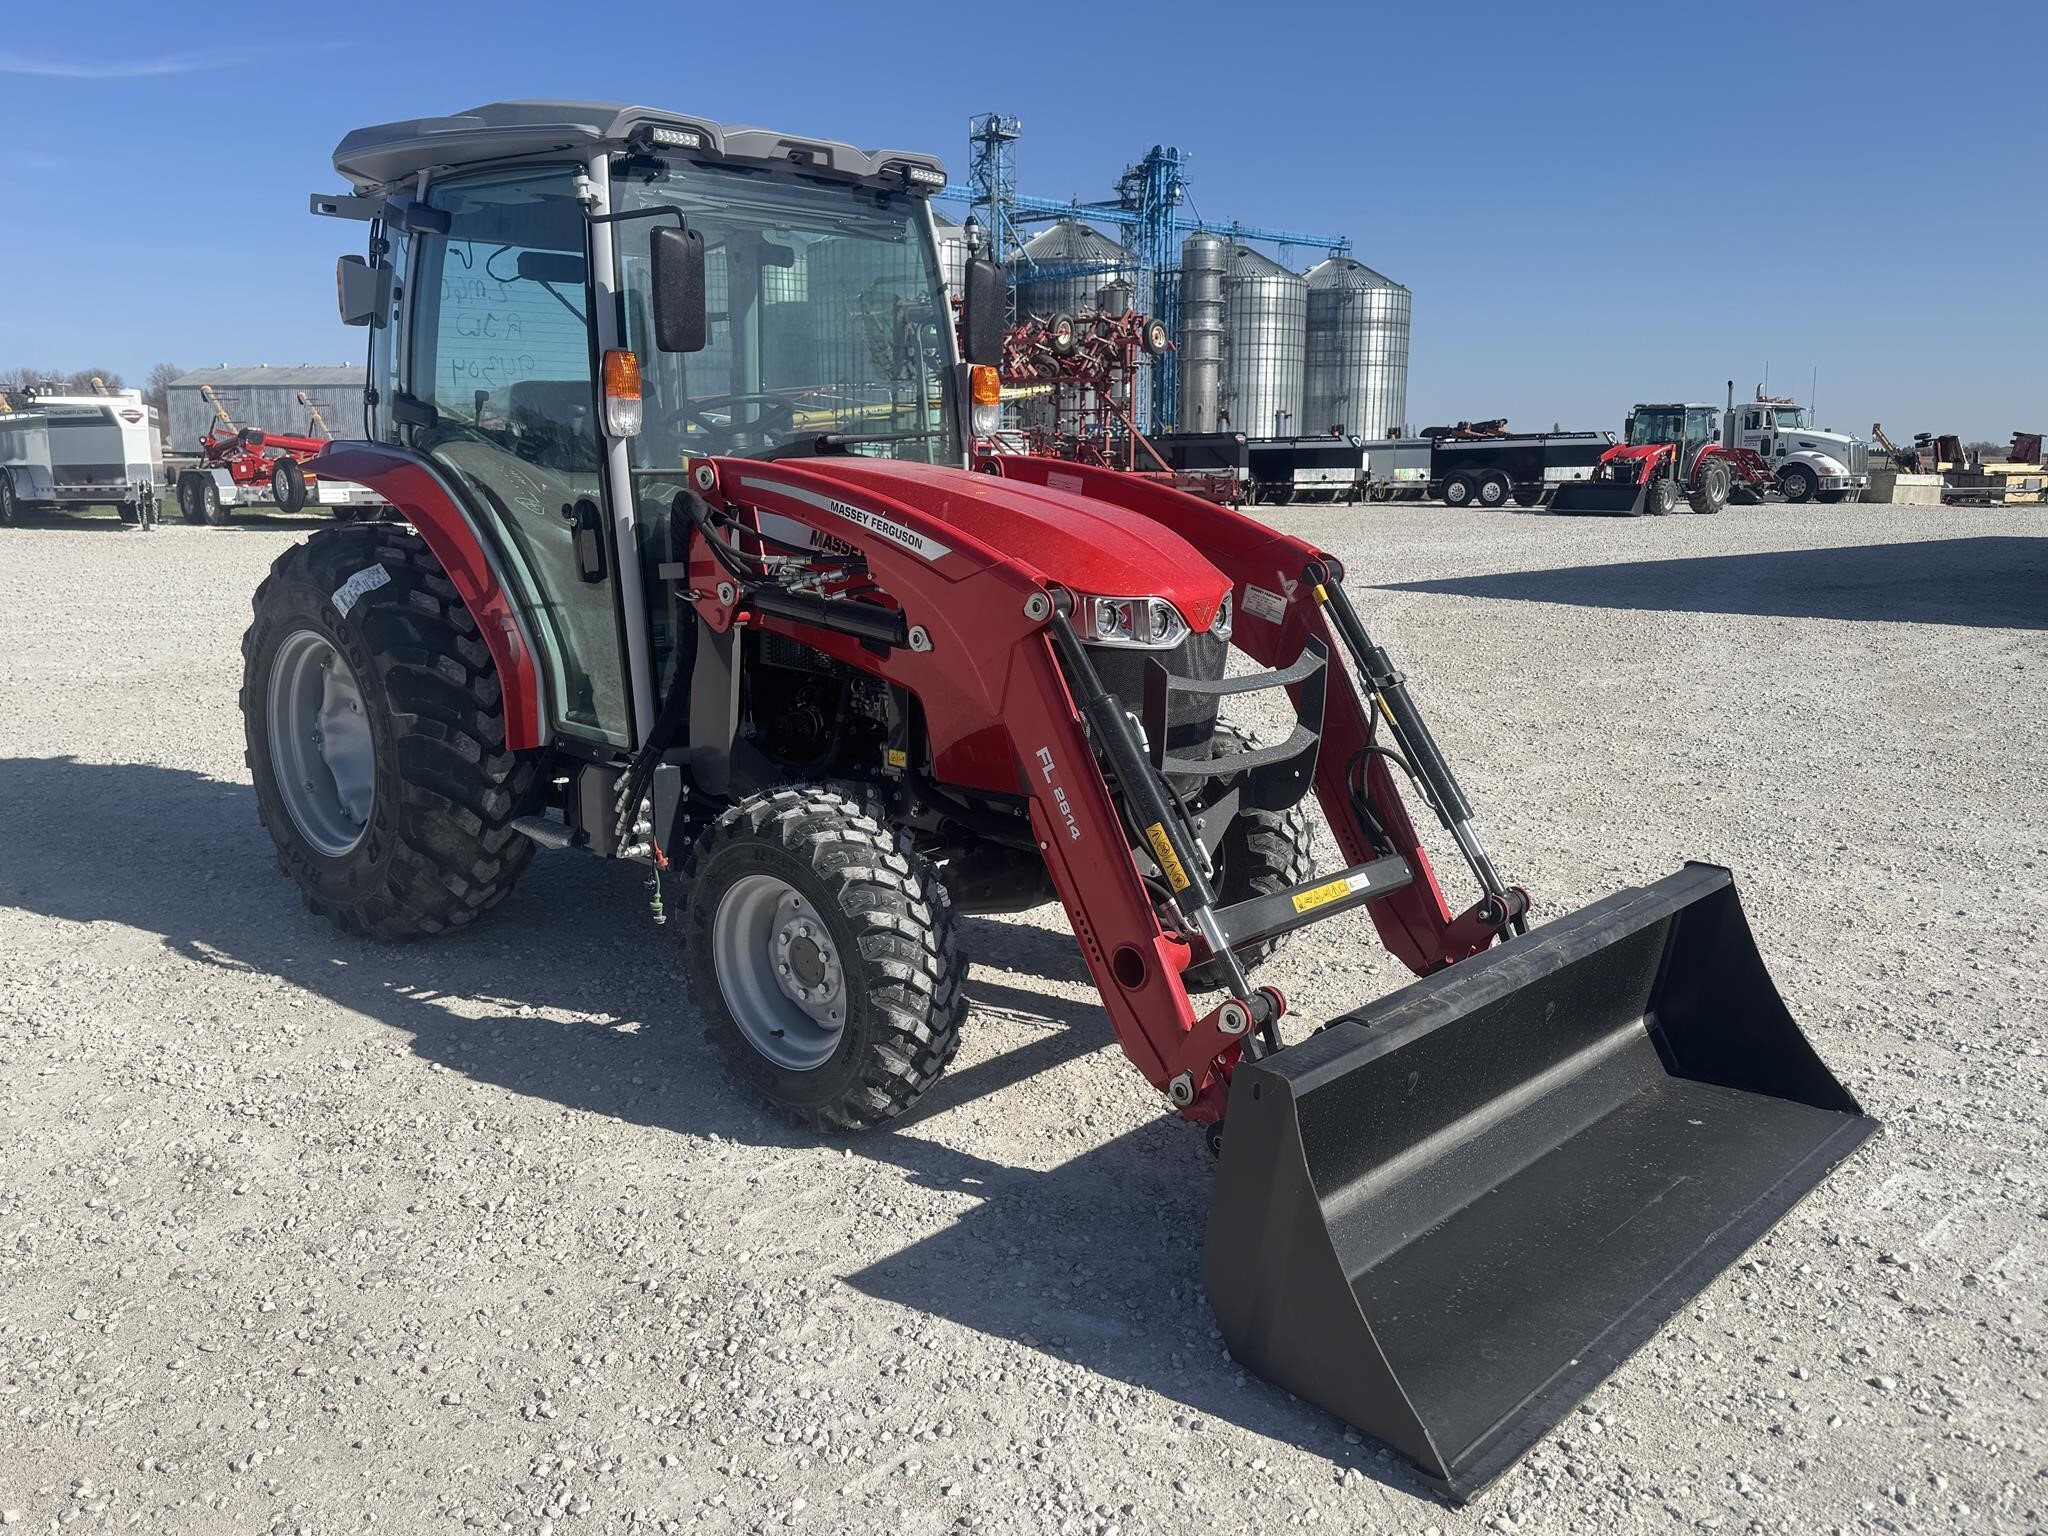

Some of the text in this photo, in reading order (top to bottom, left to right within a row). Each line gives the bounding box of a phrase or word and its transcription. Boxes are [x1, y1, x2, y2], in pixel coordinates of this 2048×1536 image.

[830, 500, 923, 551] MASSEY FERGUSON
[1035, 746, 1081, 840] FL 2814
